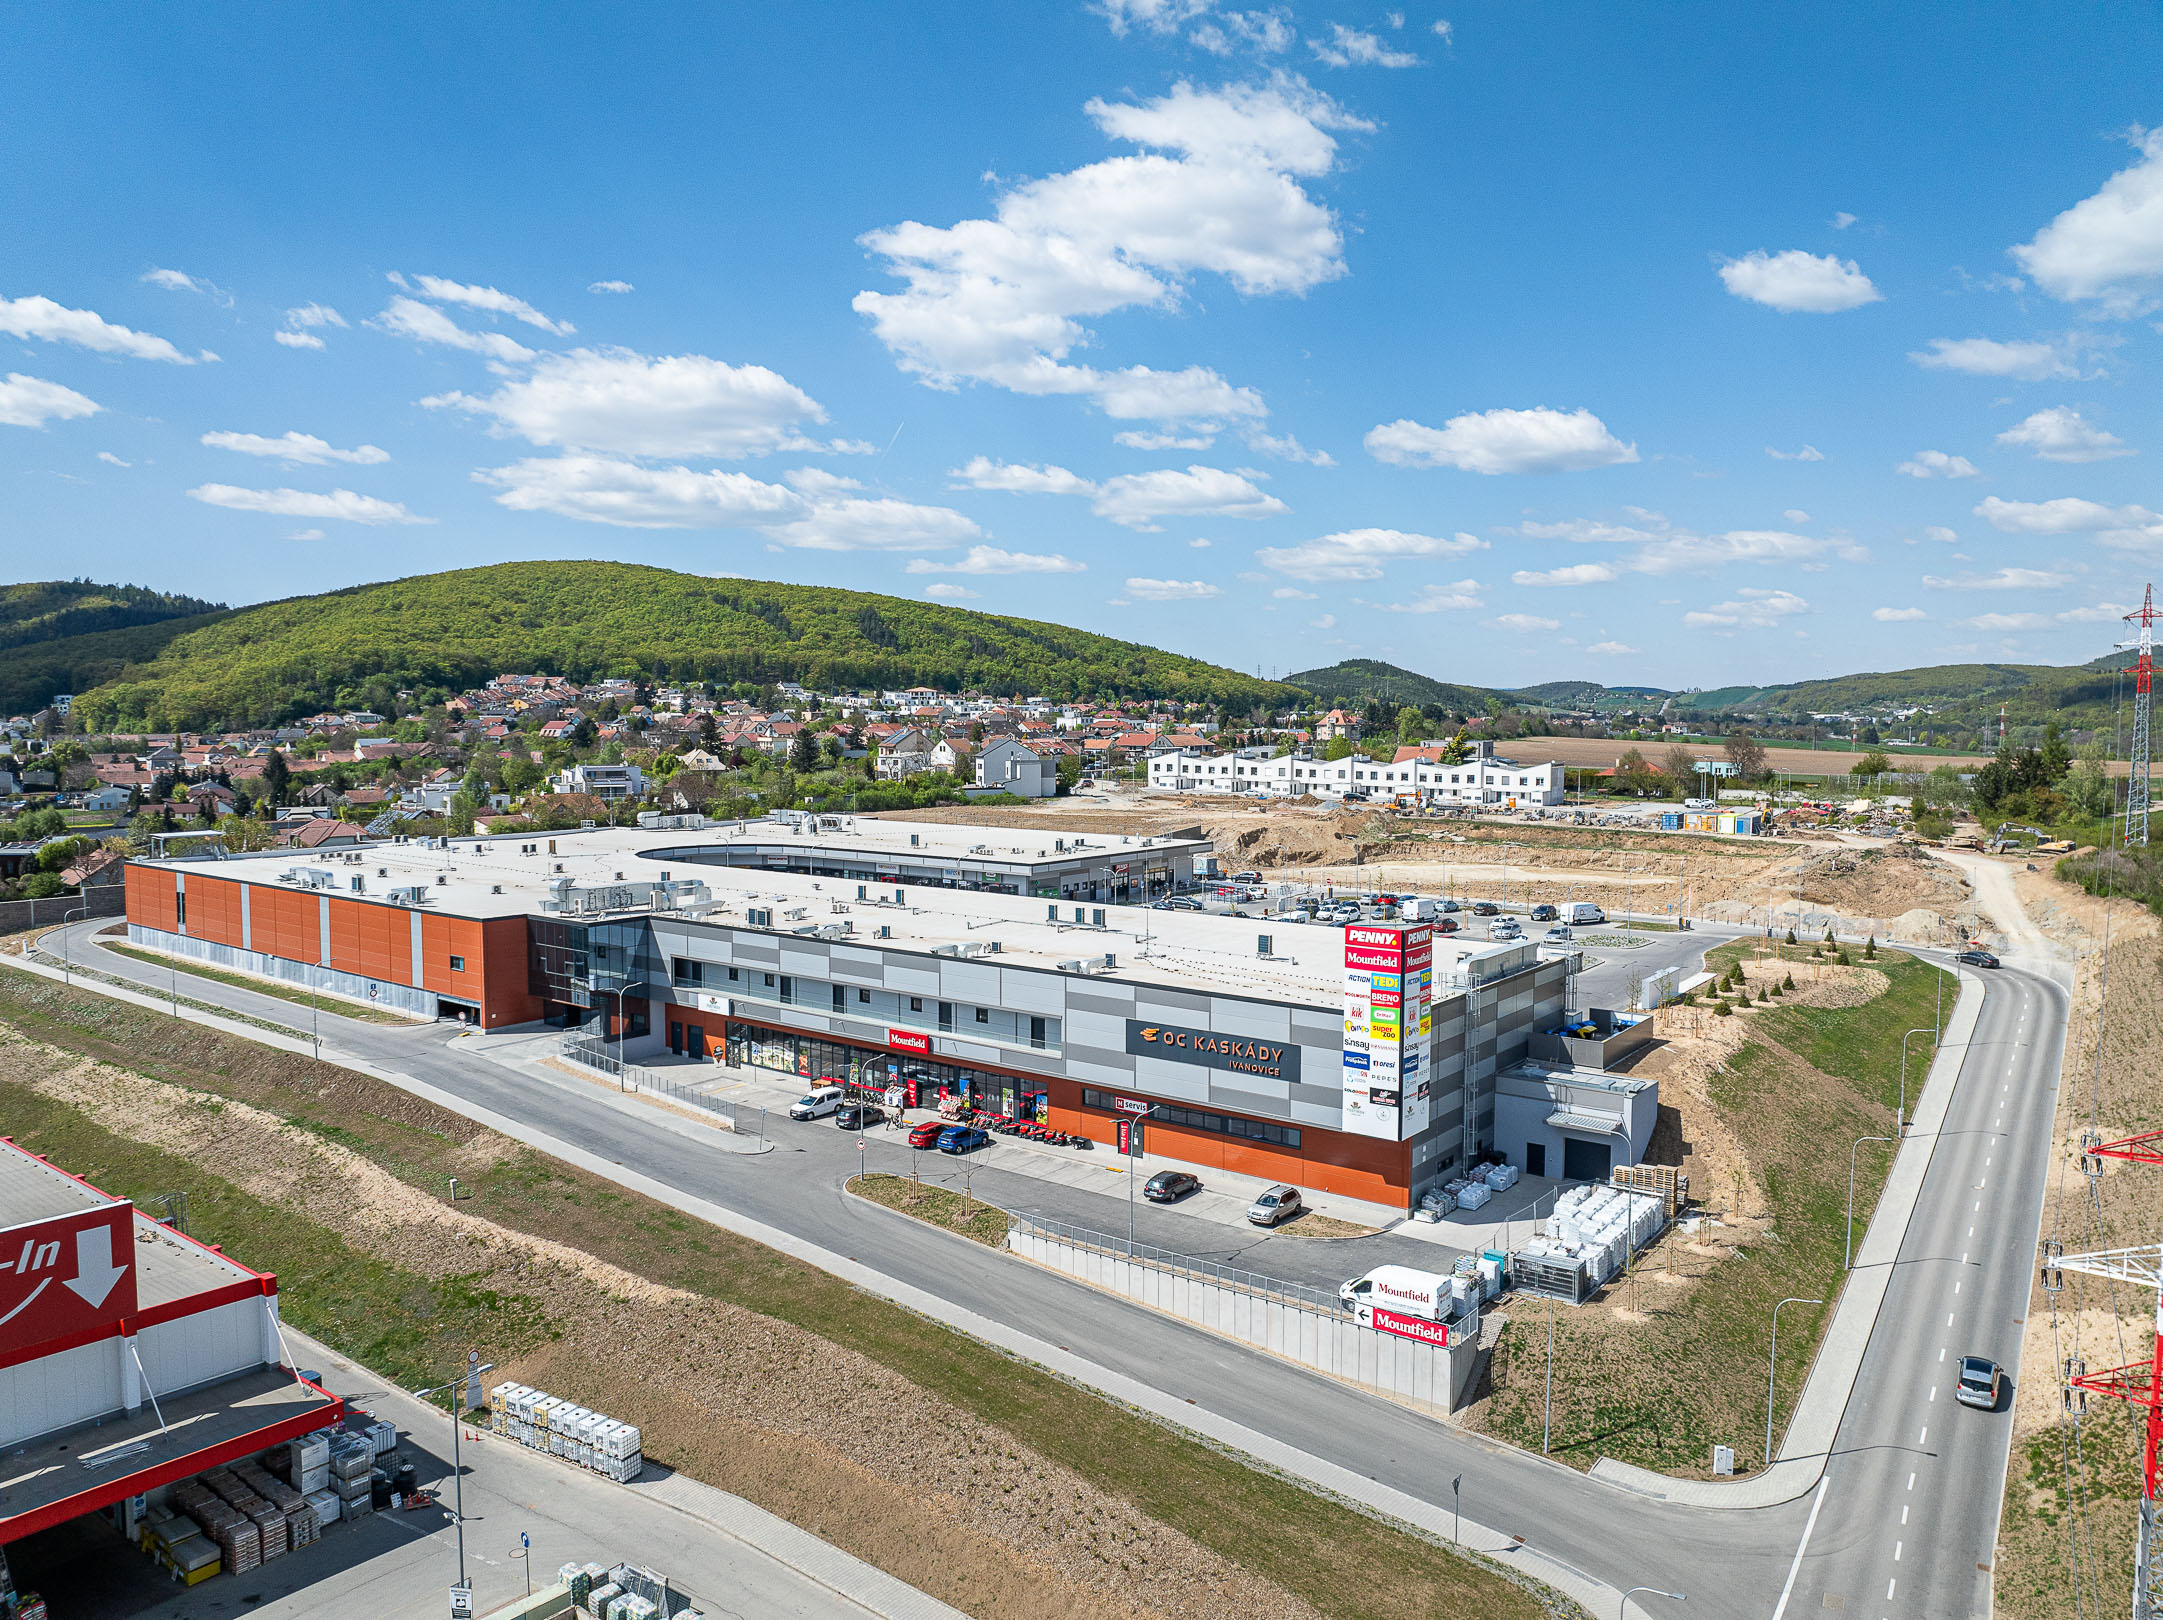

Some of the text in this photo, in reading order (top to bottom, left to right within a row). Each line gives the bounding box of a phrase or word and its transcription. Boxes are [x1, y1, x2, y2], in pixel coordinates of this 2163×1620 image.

[1348, 952, 1398, 968] Mountfield
[1348, 974, 1370, 983] ACTION
[1372, 992, 1399, 1002] BRENO
[1373, 1025, 1392, 1033] super
[891, 1034, 925, 1048] Mountfield
[1163, 1032, 1282, 1062] OC KASKÁDY
[1344, 1037, 1370, 1051] sinsay
[1230, 1060, 1280, 1076] IVANOVICE
[1125, 1101, 1146, 1111] servis
[1379, 1283, 1429, 1303] Mountfield
[1376, 1313, 1442, 1342] Mountfield
